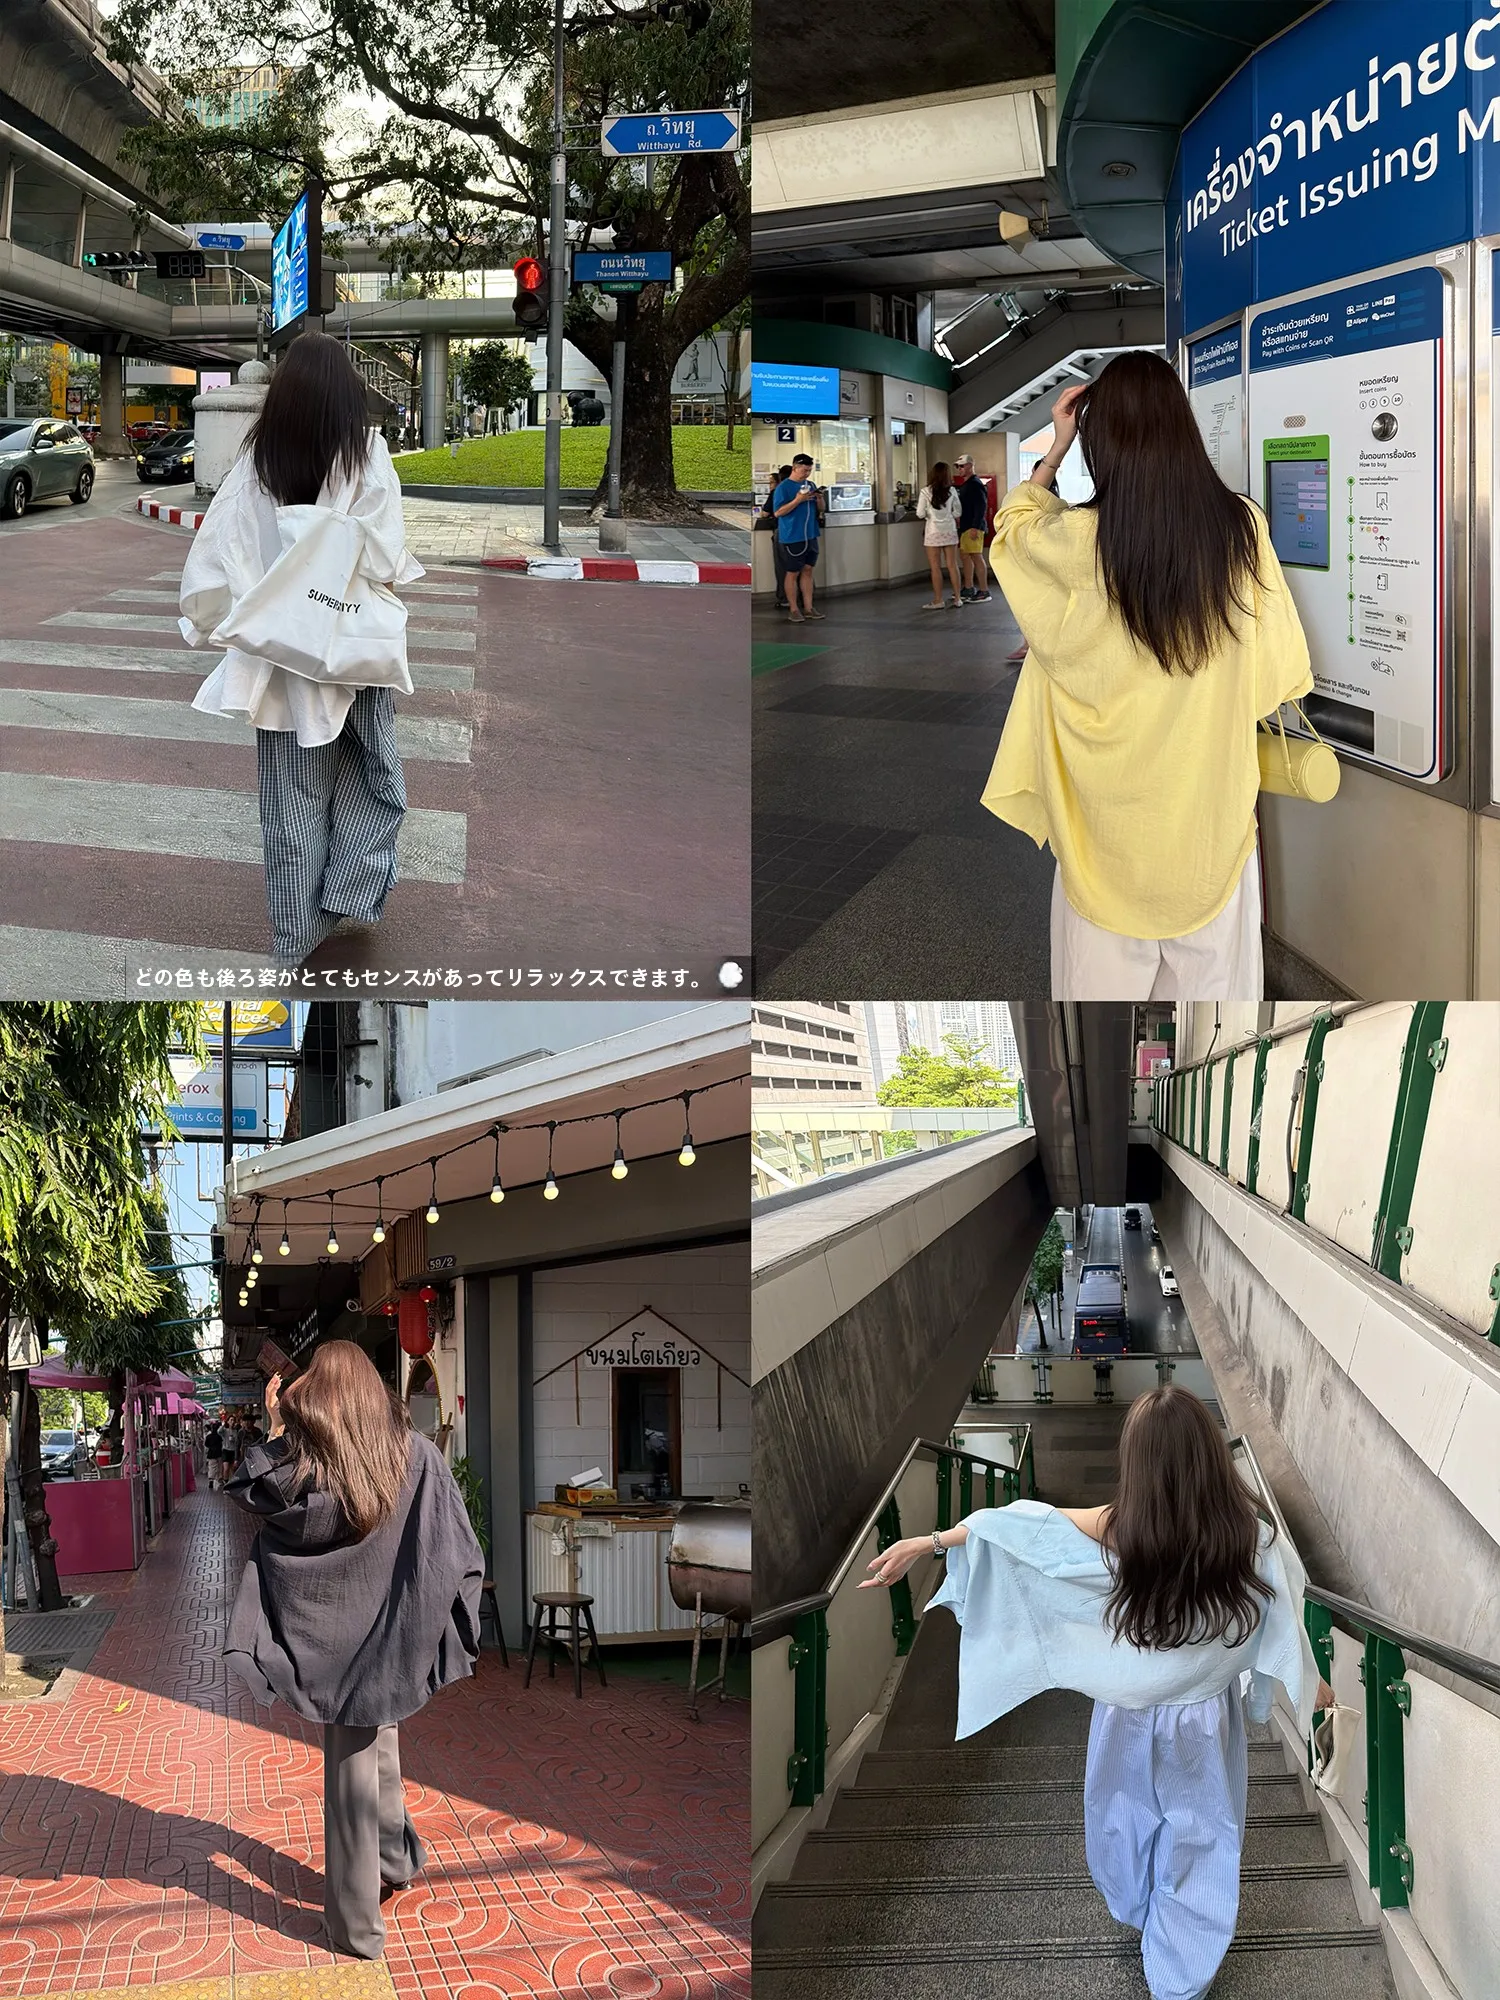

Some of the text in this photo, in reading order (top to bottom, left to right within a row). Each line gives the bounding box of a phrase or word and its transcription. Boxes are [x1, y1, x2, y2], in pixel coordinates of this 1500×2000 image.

[1187, 0, 1500, 232] เครื่องจำหน่ายต
[637, 140, 703, 151] Witthayu Rd.
[1219, 194, 1289, 256] Ticket
[1300, 133, 1438, 218] Issuing
[600, 255, 646, 271] ถนนวิทยุ
[1262, 313, 1329, 336] ชำระเงินด้วยเหรียญ
[1353, 317, 1369, 325] Alipay
[1262, 329, 1309, 348] หรือสแกนจ่าย
[1262, 350, 1272, 358] Pay
[1272, 347, 1284, 355] with
[1285, 344, 1300, 353] Coins
[1309, 339, 1323, 347] Scan
[1323, 335, 1334, 345] QR
[1359, 375, 1399, 386] หยอดเหรียญ
[782, 429, 791, 440] 2
[1359, 448, 1417, 460] ขั้นตอนการซื้อบัตร
[1336, 689, 1352, 698] change
[1337, 681, 1371, 696] และเงินทอน
[178, 1082, 210, 1095] erox
[195, 1112, 204, 1122] &
[206, 1112, 246, 1126] Copng
[429, 1256, 454, 1270] 59/2
[586, 1331, 701, 1366] ขนมโตเกียว
